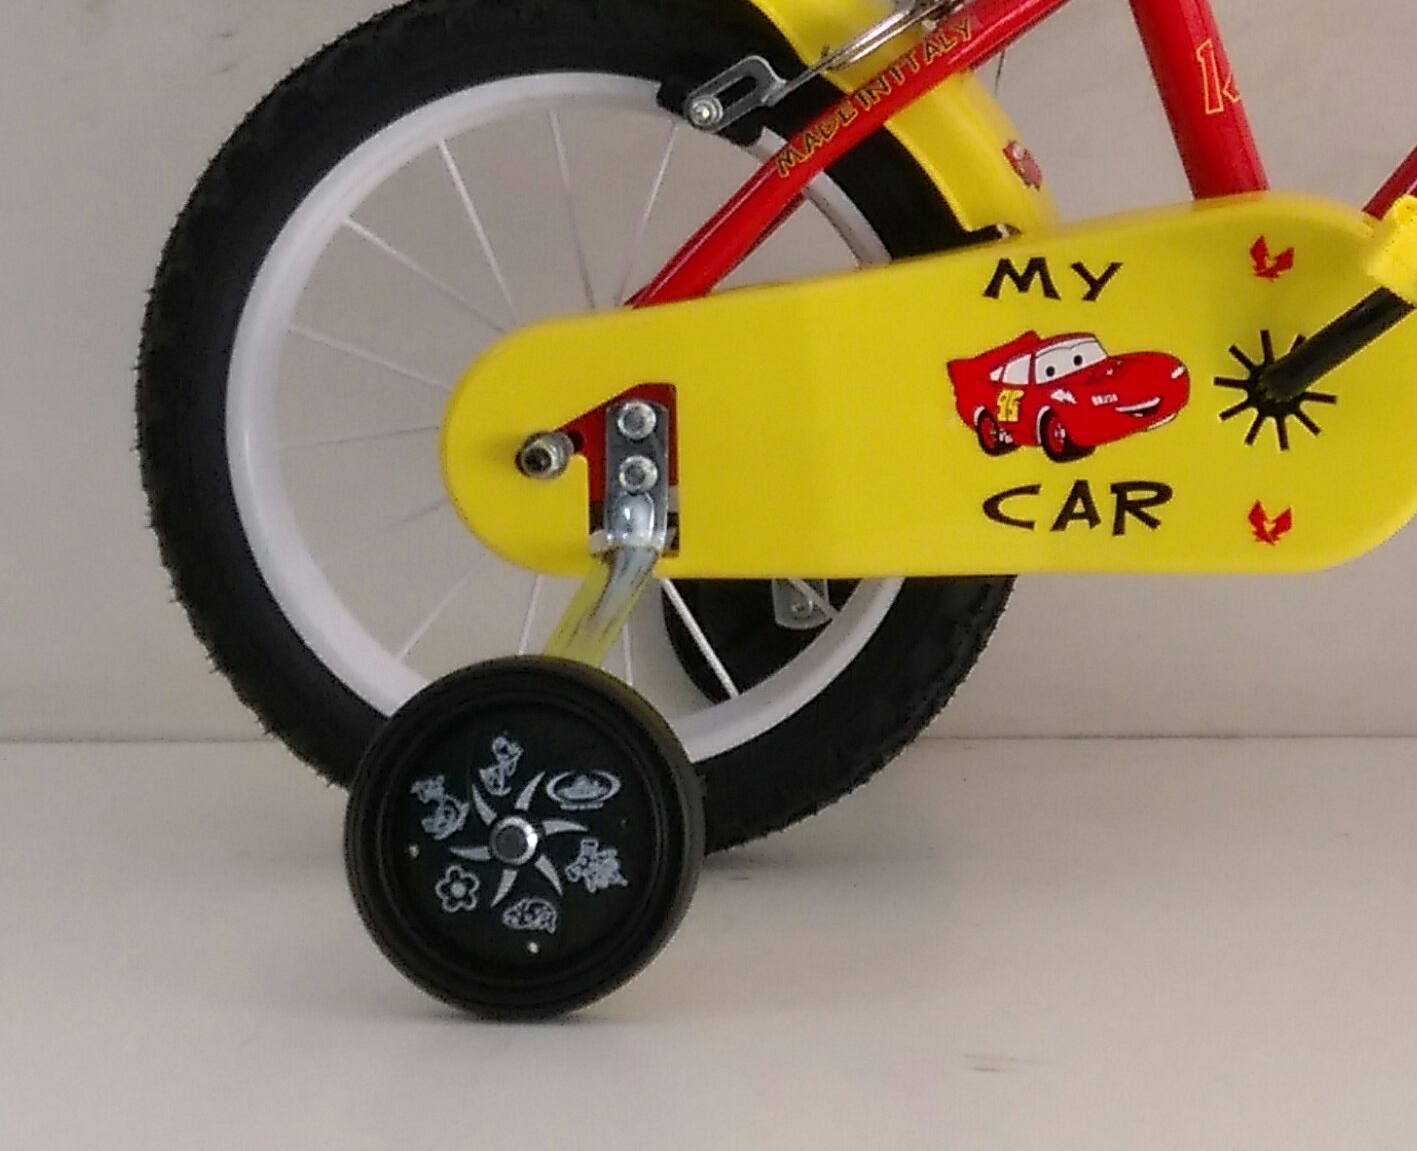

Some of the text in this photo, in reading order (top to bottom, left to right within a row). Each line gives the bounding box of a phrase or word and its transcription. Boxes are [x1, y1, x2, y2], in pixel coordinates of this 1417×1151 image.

[776, 97, 859, 178] MADE
[982, 256, 1124, 302] MY
[982, 479, 1174, 536] CAR
